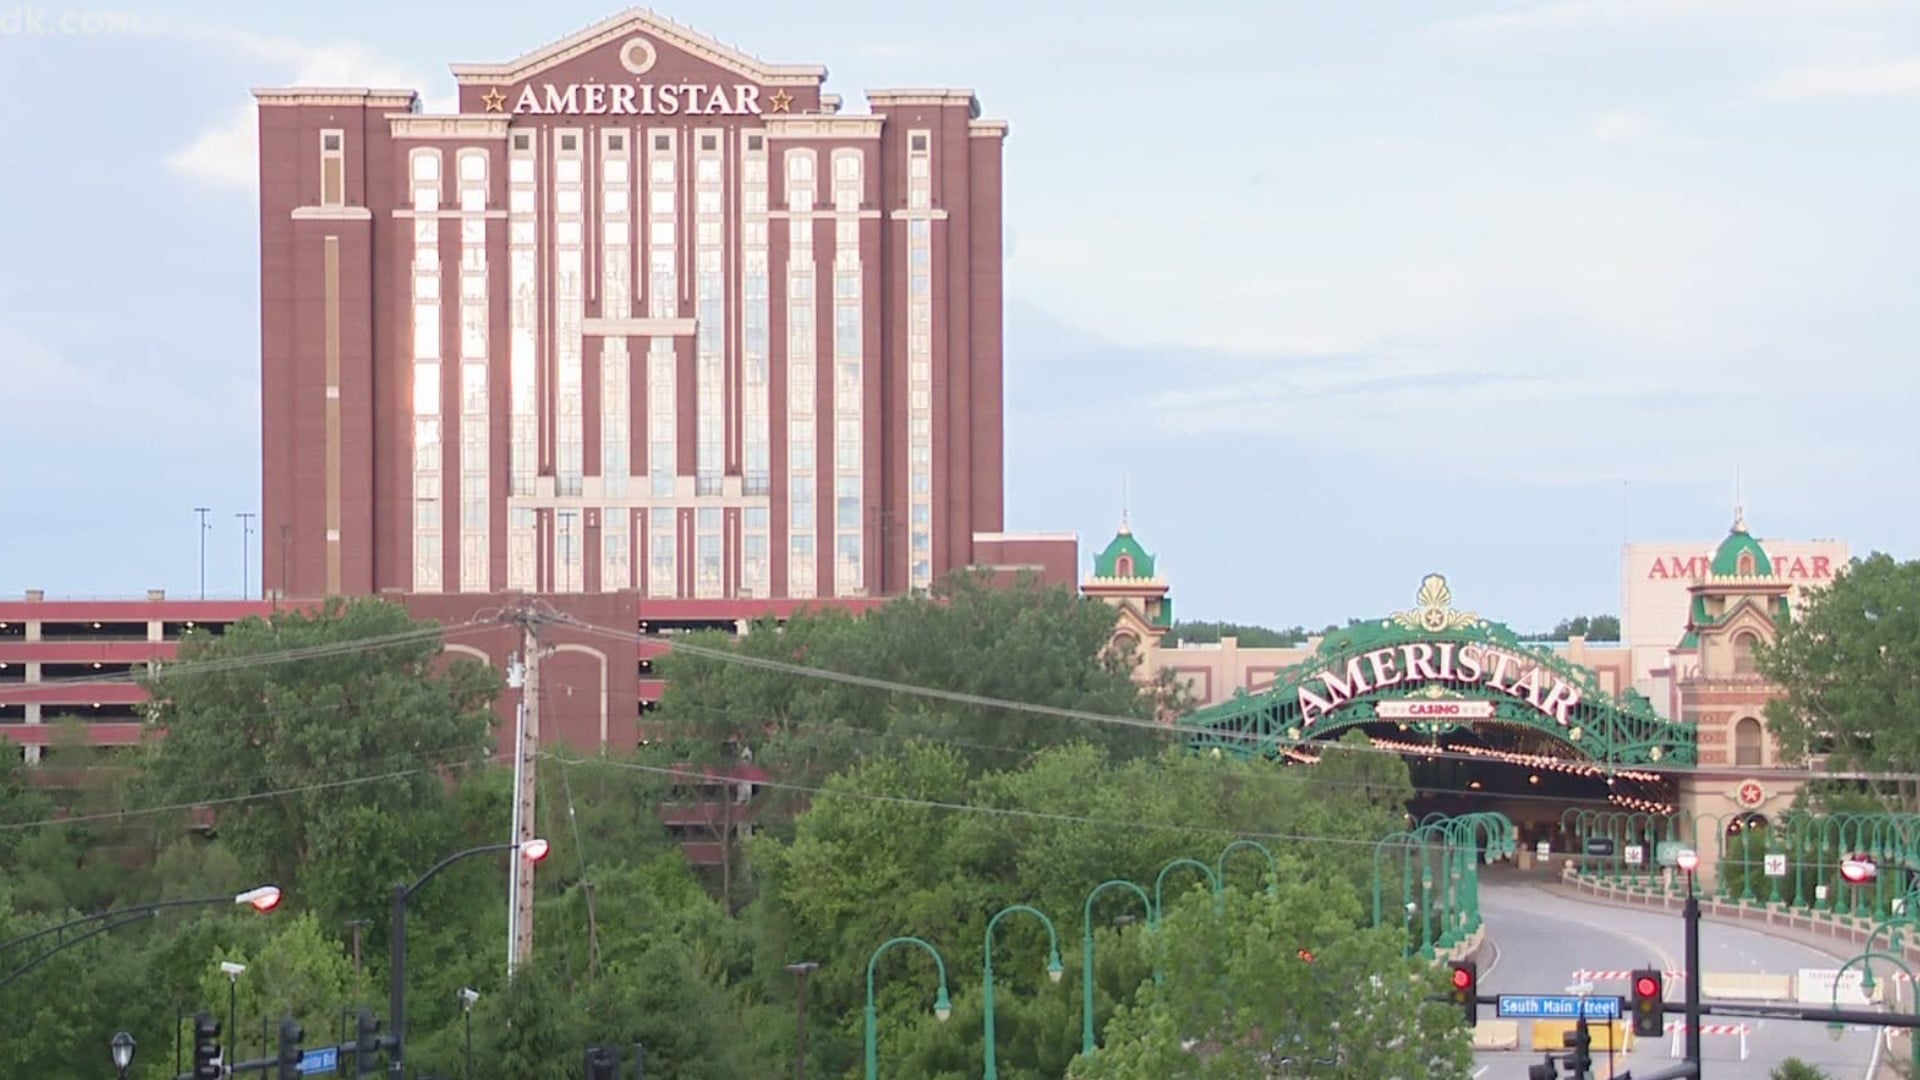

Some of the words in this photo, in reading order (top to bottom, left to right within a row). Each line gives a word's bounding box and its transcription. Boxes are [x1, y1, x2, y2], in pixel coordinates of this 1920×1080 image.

[512, 83, 763, 116] AMERISTAR
[1648, 555, 1833, 579] AMTAR
[1298, 641, 1582, 727] AMERISTAR
[1409, 704, 1459, 714] CASINO
[1502, 999, 1539, 1014] South
[1543, 1000, 1573, 1014] Main
